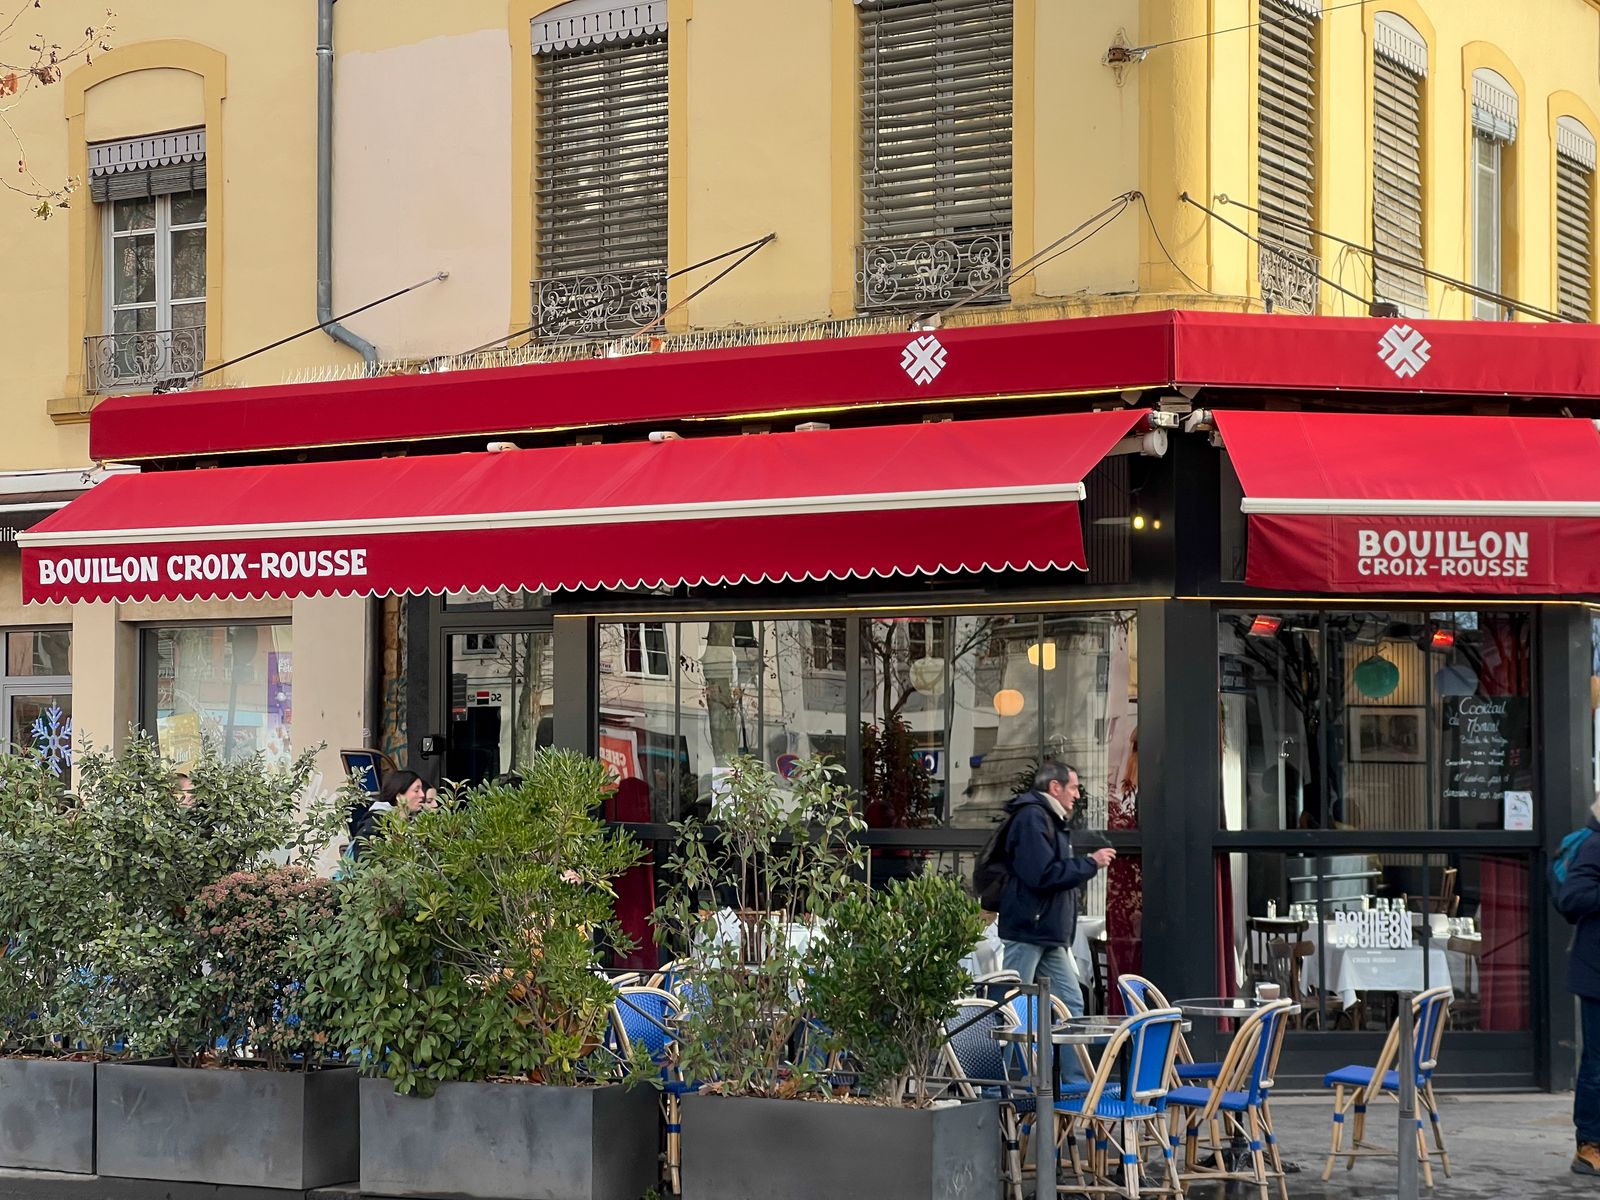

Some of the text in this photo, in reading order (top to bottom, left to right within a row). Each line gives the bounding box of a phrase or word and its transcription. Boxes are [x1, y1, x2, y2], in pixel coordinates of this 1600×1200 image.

[1359, 531, 1528, 557] BOUILLON
[39, 549, 367, 584] BOUILLON CROIX-ROUSSE
[1359, 559, 1527, 576] CROIX-ROUSSE
